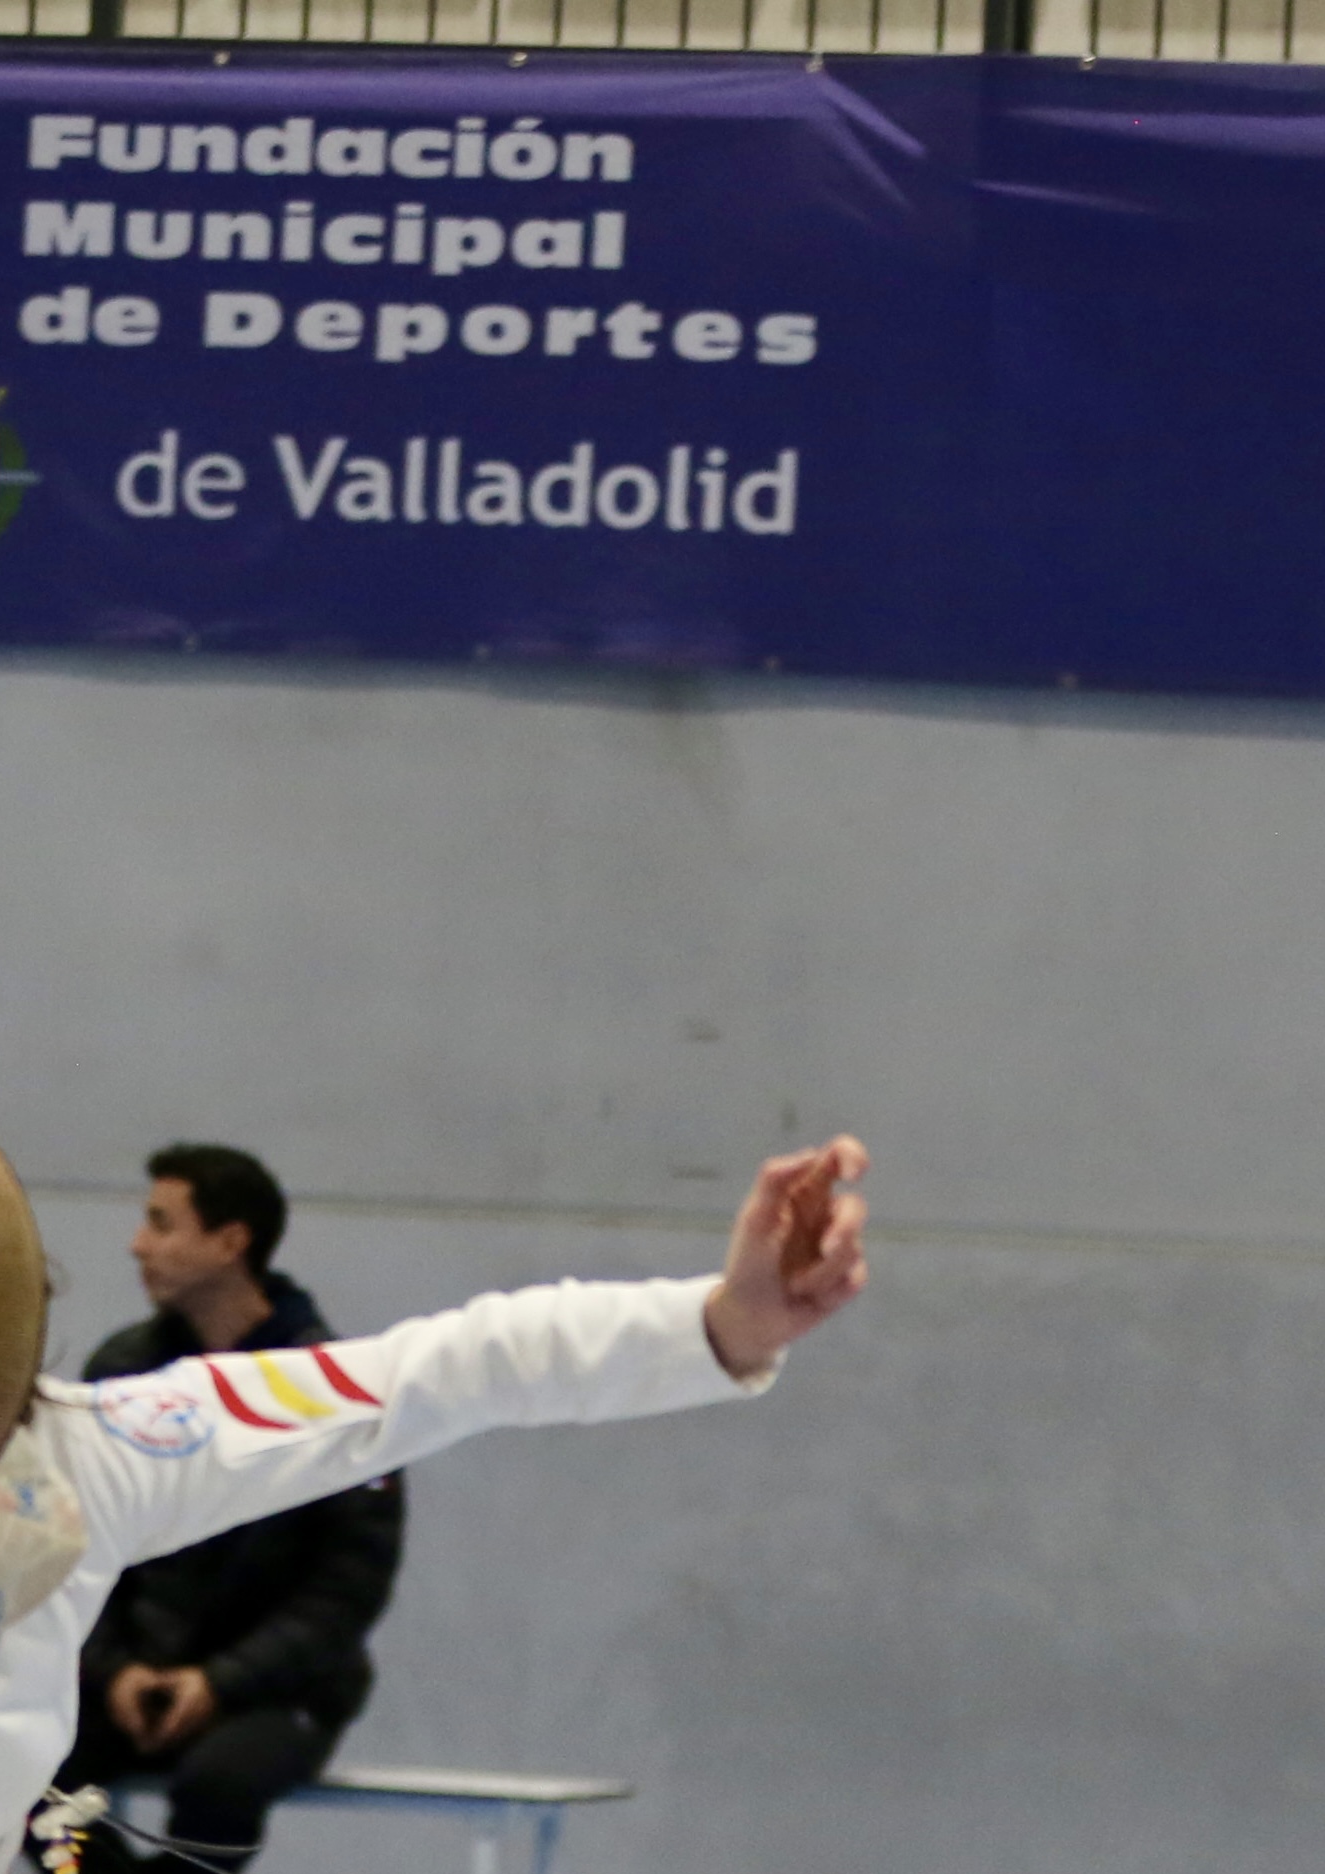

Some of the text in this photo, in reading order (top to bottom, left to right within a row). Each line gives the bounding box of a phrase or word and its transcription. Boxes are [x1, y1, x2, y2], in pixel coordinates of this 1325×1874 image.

[28, 114, 635, 182] Fundación
[23, 200, 626, 276] Municipal
[18, 286, 818, 365] de Deportes
[116, 429, 245, 520] de
[274, 435, 798, 535] Valladolid
